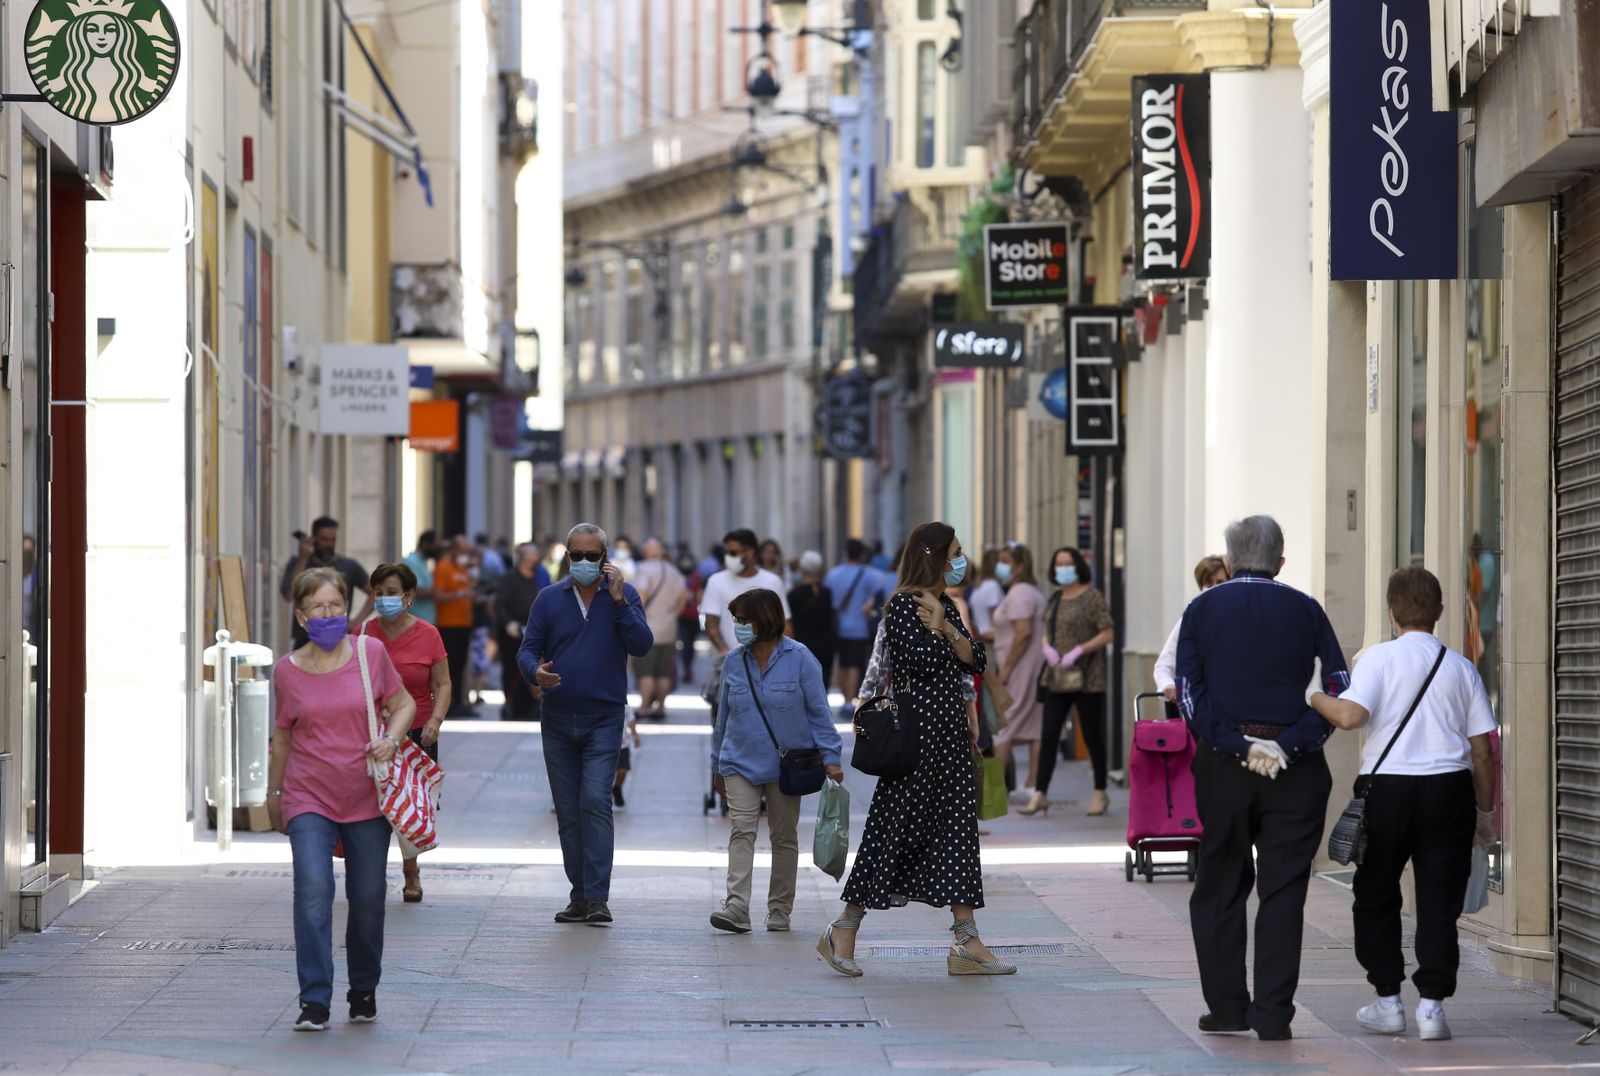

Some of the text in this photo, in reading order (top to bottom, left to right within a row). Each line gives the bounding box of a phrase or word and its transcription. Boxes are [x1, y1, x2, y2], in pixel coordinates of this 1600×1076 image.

[1141, 83, 1177, 270] PRIMOR
[991, 238, 1067, 260] Mobile
[999, 260, 1061, 283] Store
[331, 367, 396, 382] MARKS &
[329, 384, 399, 399] SPENCER
